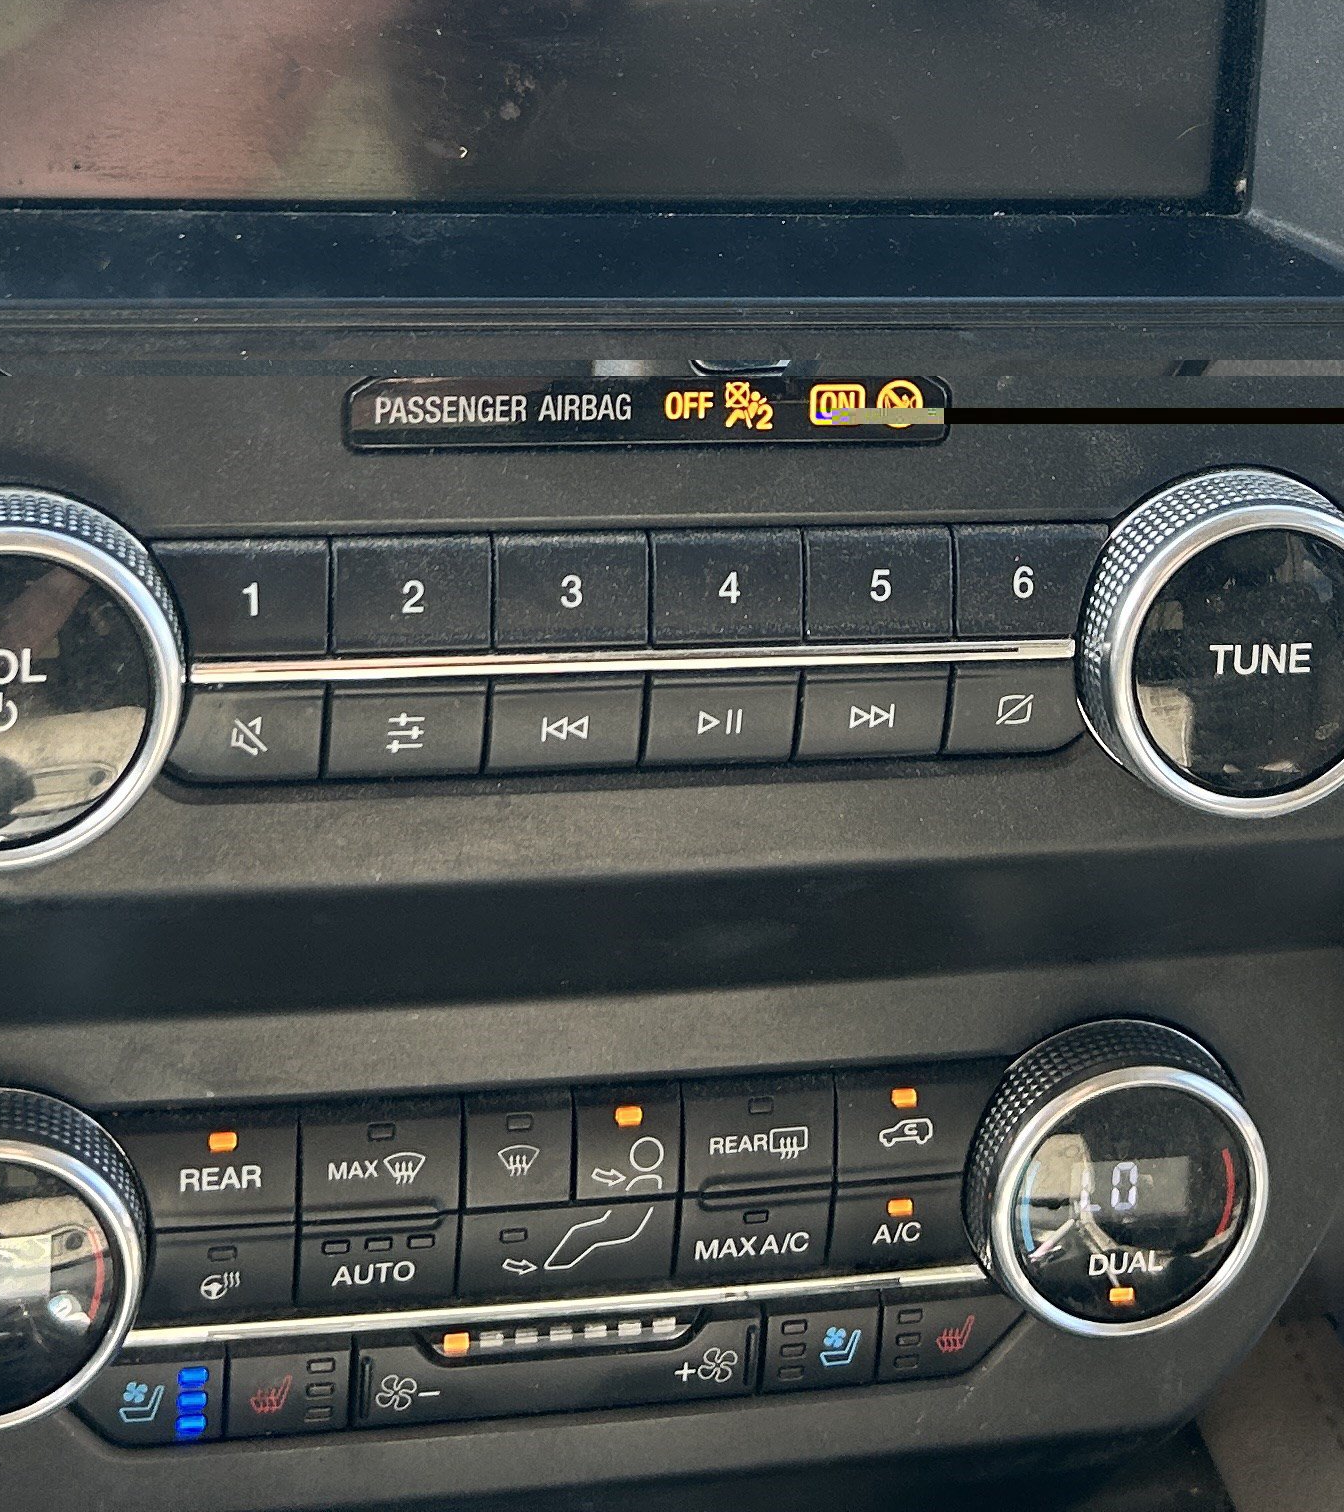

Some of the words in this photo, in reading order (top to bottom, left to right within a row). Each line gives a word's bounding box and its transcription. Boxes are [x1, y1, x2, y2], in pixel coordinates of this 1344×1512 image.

[374, 394, 528, 425] PASSENGER
[538, 393, 633, 422] AIRBAG
[664, 391, 714, 420] OFF
[241, 581, 259, 616] 1
[401, 579, 426, 613] 2
[559, 574, 584, 609] 3
[717, 570, 741, 604] 4
[869, 568, 893, 602] 5
[1012, 565, 1036, 600] 6
[1209, 641, 1313, 675] TUNE
[709, 1134, 768, 1156] REAR
[179, 1164, 263, 1192] REAR
[327, 1159, 379, 1181] MAX
[694, 1236, 757, 1261] MAX
[761, 1231, 811, 1256] A/C
[872, 1221, 922, 1246] A/C
[331, 1261, 417, 1288] AUTO
[1088, 1251, 1164, 1277] DUAL
